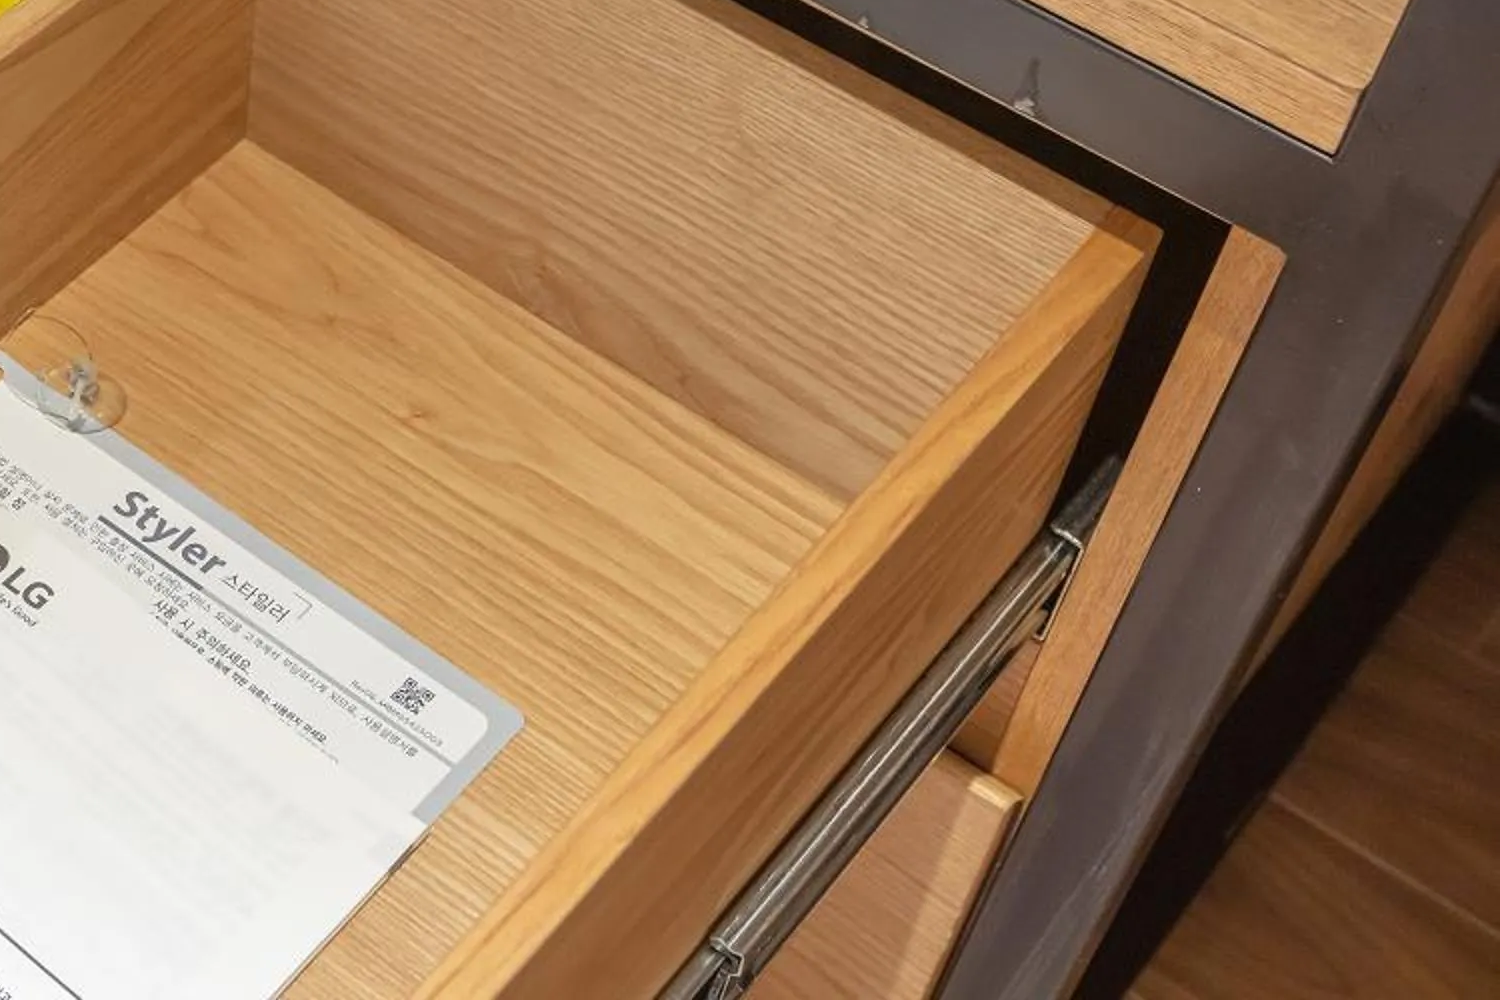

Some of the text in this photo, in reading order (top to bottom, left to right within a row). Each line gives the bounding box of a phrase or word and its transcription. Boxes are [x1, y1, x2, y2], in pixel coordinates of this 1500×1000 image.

[112, 491, 290, 624] Styler 스타일러
[1, 566, 54, 610] LG
[153, 599, 179, 620] 사용
